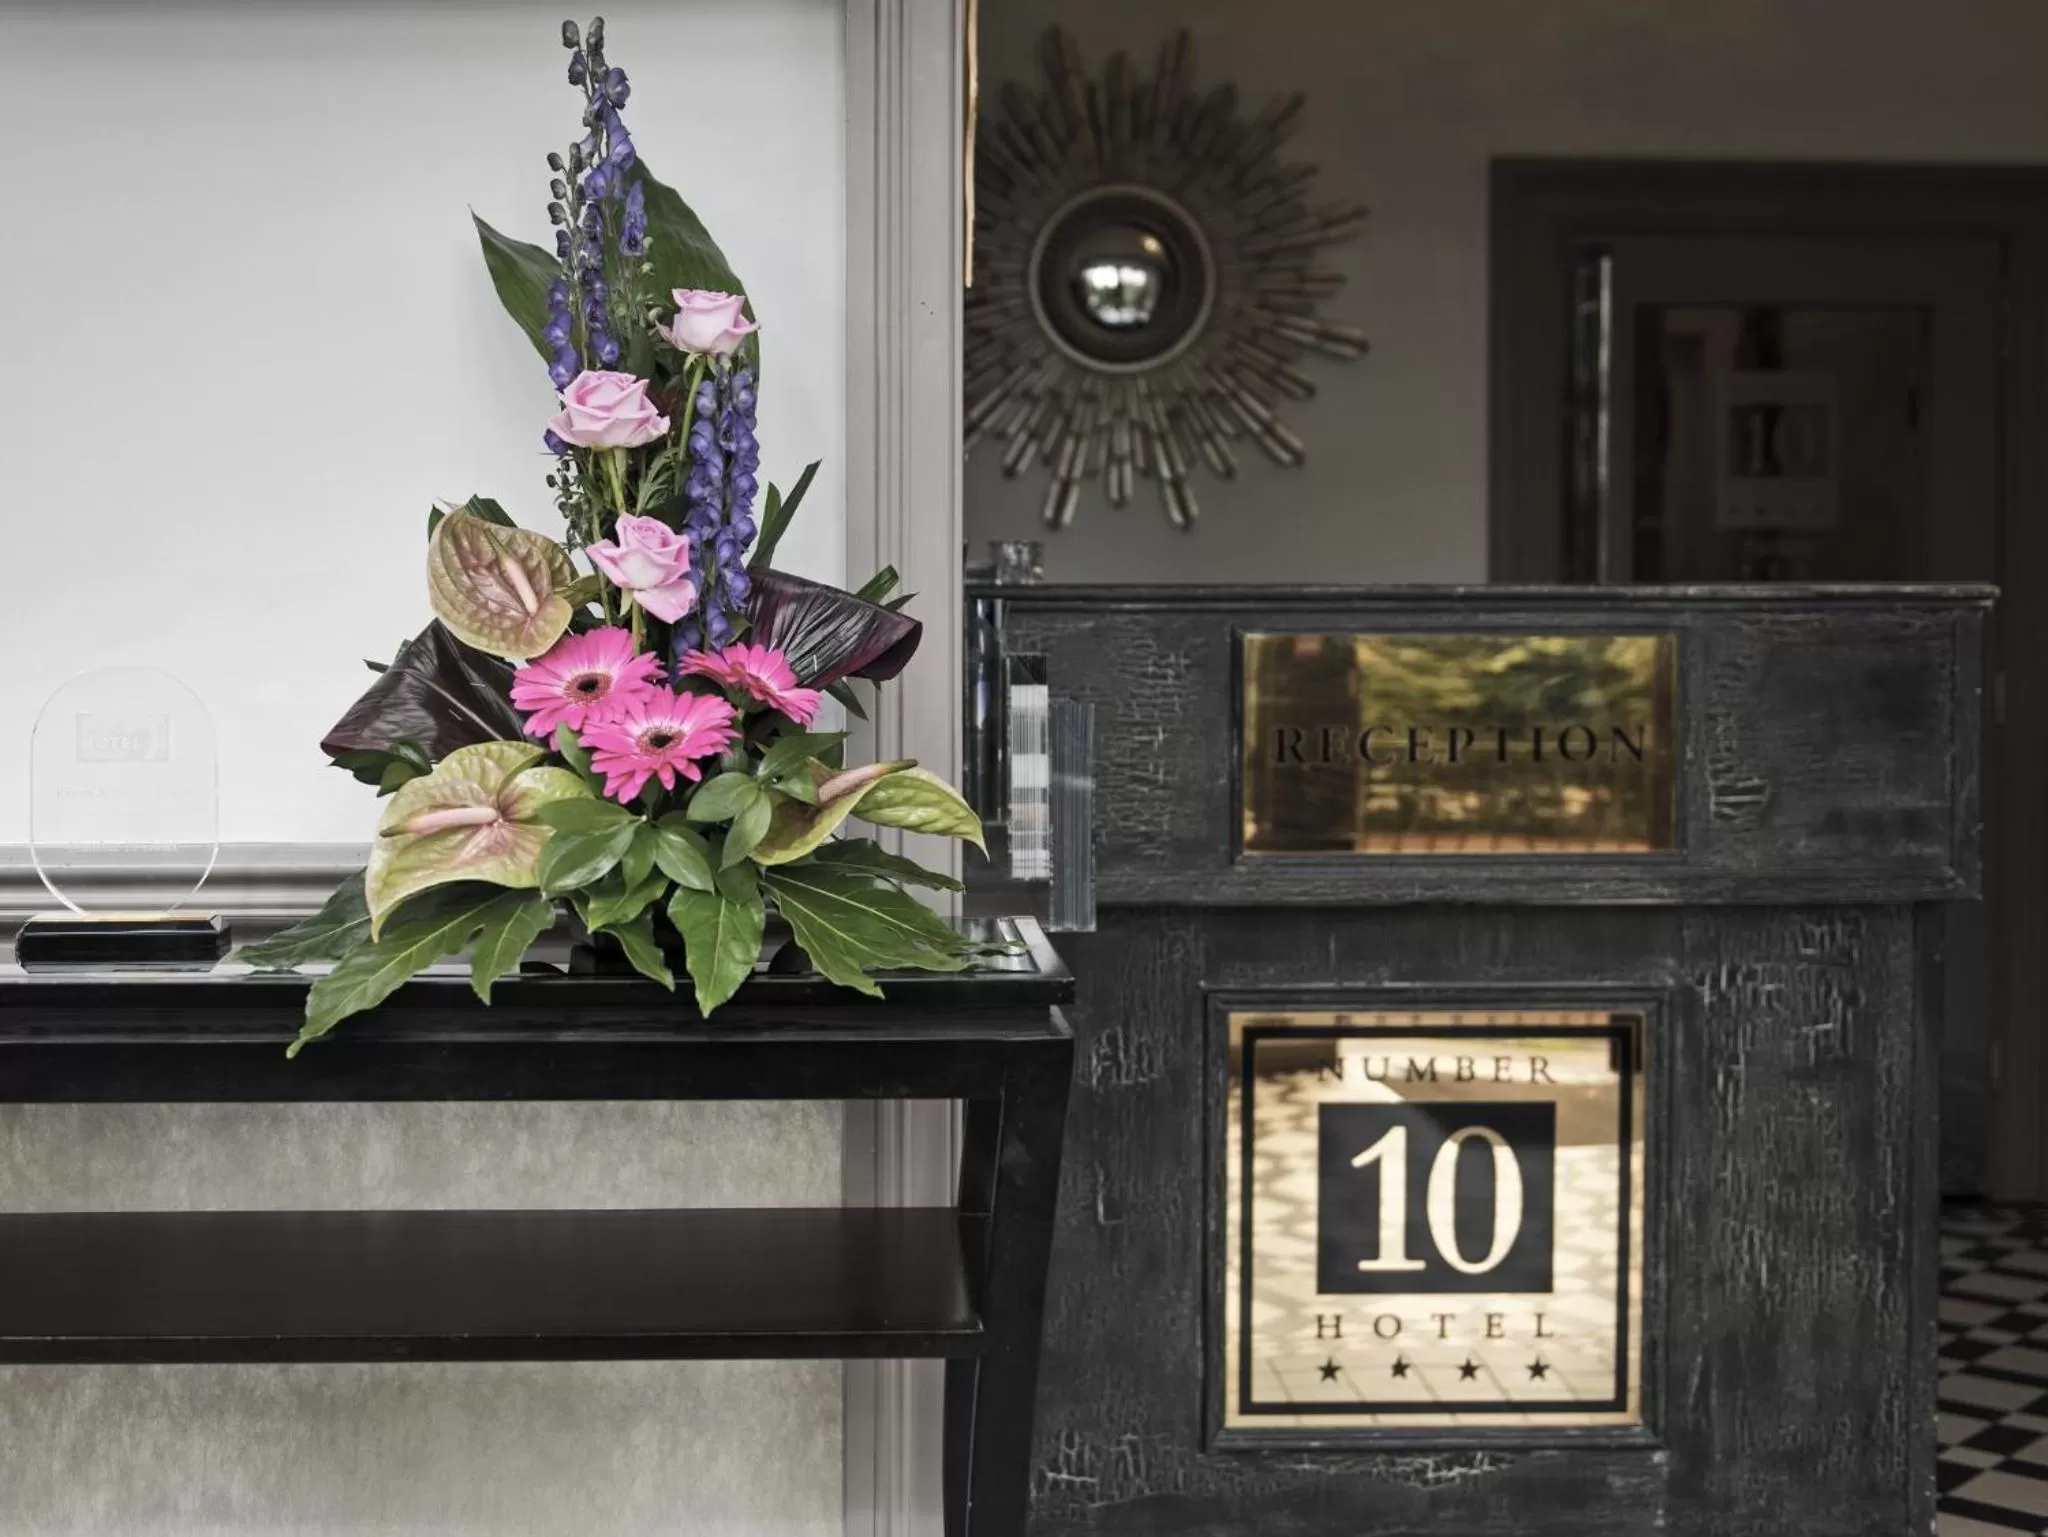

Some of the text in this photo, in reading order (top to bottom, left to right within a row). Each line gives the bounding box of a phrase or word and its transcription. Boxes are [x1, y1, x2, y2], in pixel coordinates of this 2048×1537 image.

[1273, 723, 1646, 764] RECEPTION
[1317, 1056, 1557, 1084] NUMBER
[1351, 1125, 1524, 1275] 10
[1315, 1312, 1555, 1340] HOTEL
